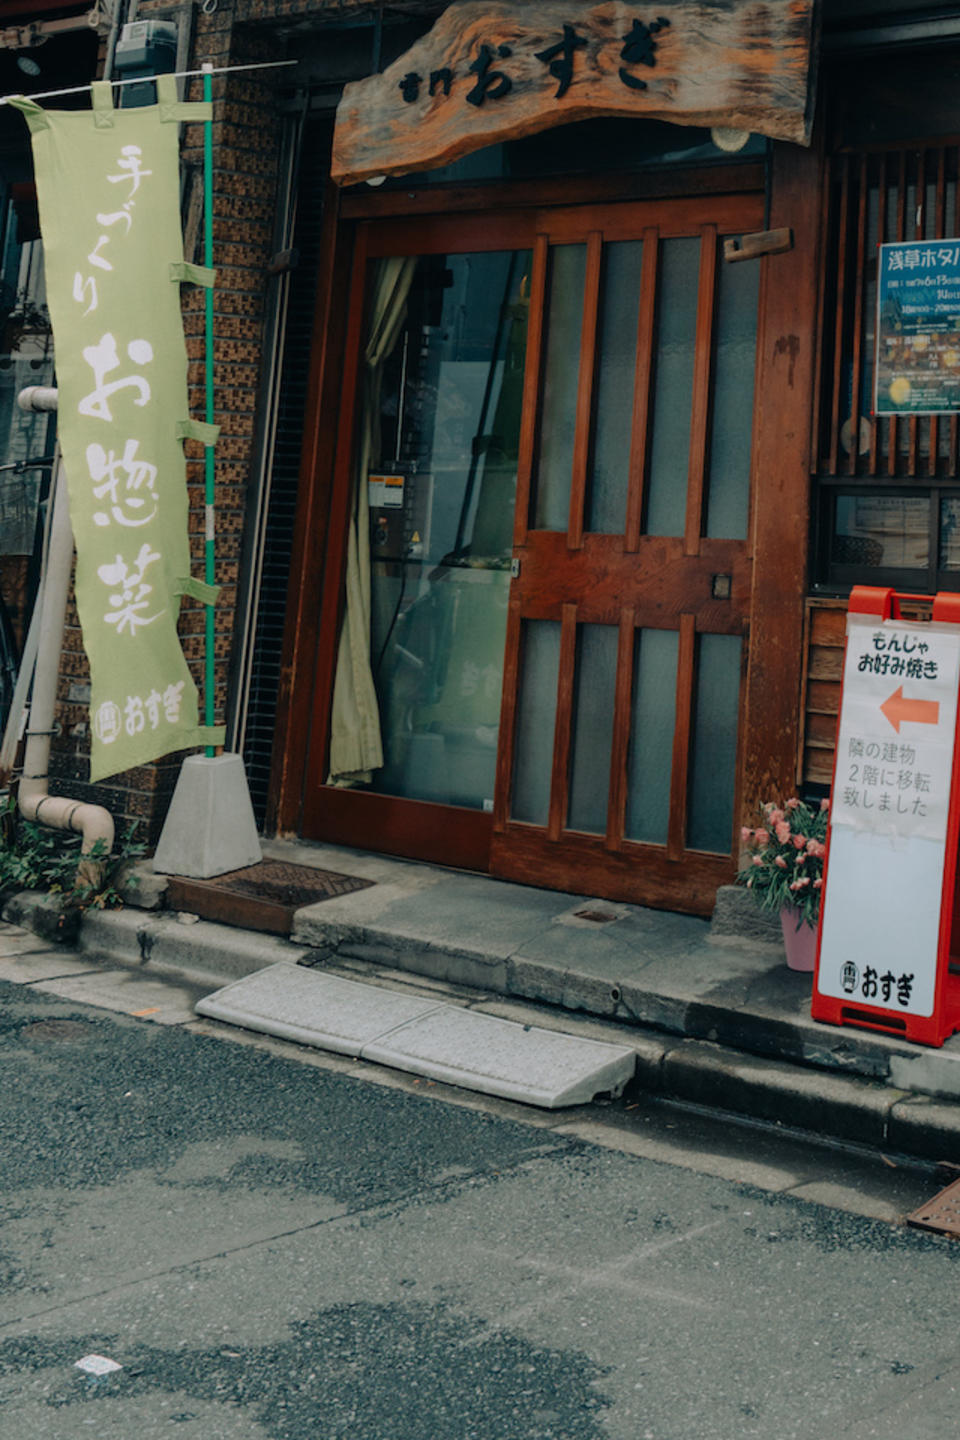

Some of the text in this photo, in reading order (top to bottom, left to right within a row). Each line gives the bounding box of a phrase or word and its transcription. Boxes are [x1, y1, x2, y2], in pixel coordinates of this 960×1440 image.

[73, 145, 152, 318] 手づくり
[78, 332, 168, 637] お惣菜
[872, 631, 929, 655] もんじゃ
[857, 652, 939, 680] お好み焼き
[848, 737, 917, 766] 隣の建物
[848, 763, 932, 794] 2階に移転
[843, 786, 928, 817] 致しました
[862, 965, 914, 1006] おすぎ
